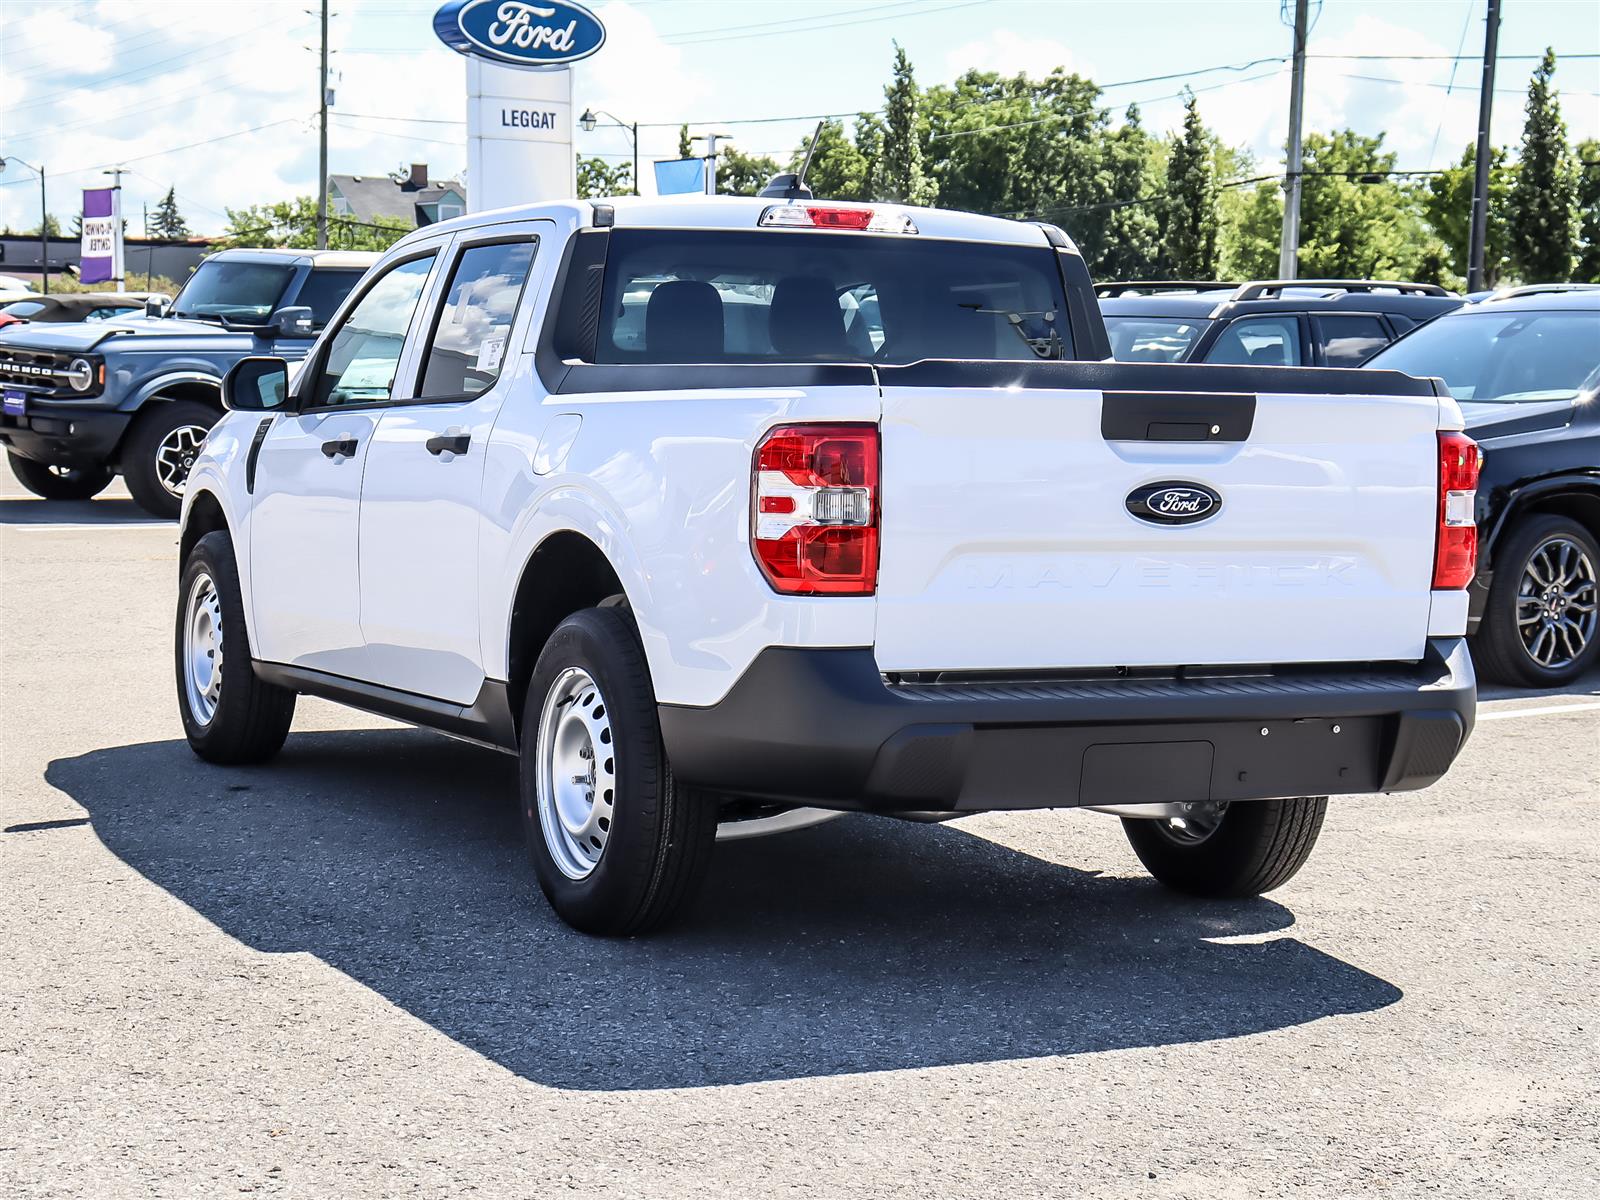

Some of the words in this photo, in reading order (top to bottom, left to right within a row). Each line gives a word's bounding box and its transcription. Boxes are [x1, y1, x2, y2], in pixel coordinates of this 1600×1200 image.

[489, 2, 576, 51] Ford
[502, 109, 556, 129] LEGGAT
[0, 363, 52, 376] RONCO
[1160, 491, 1201, 512] Ford
[965, 558, 1359, 590] MAVERICK
